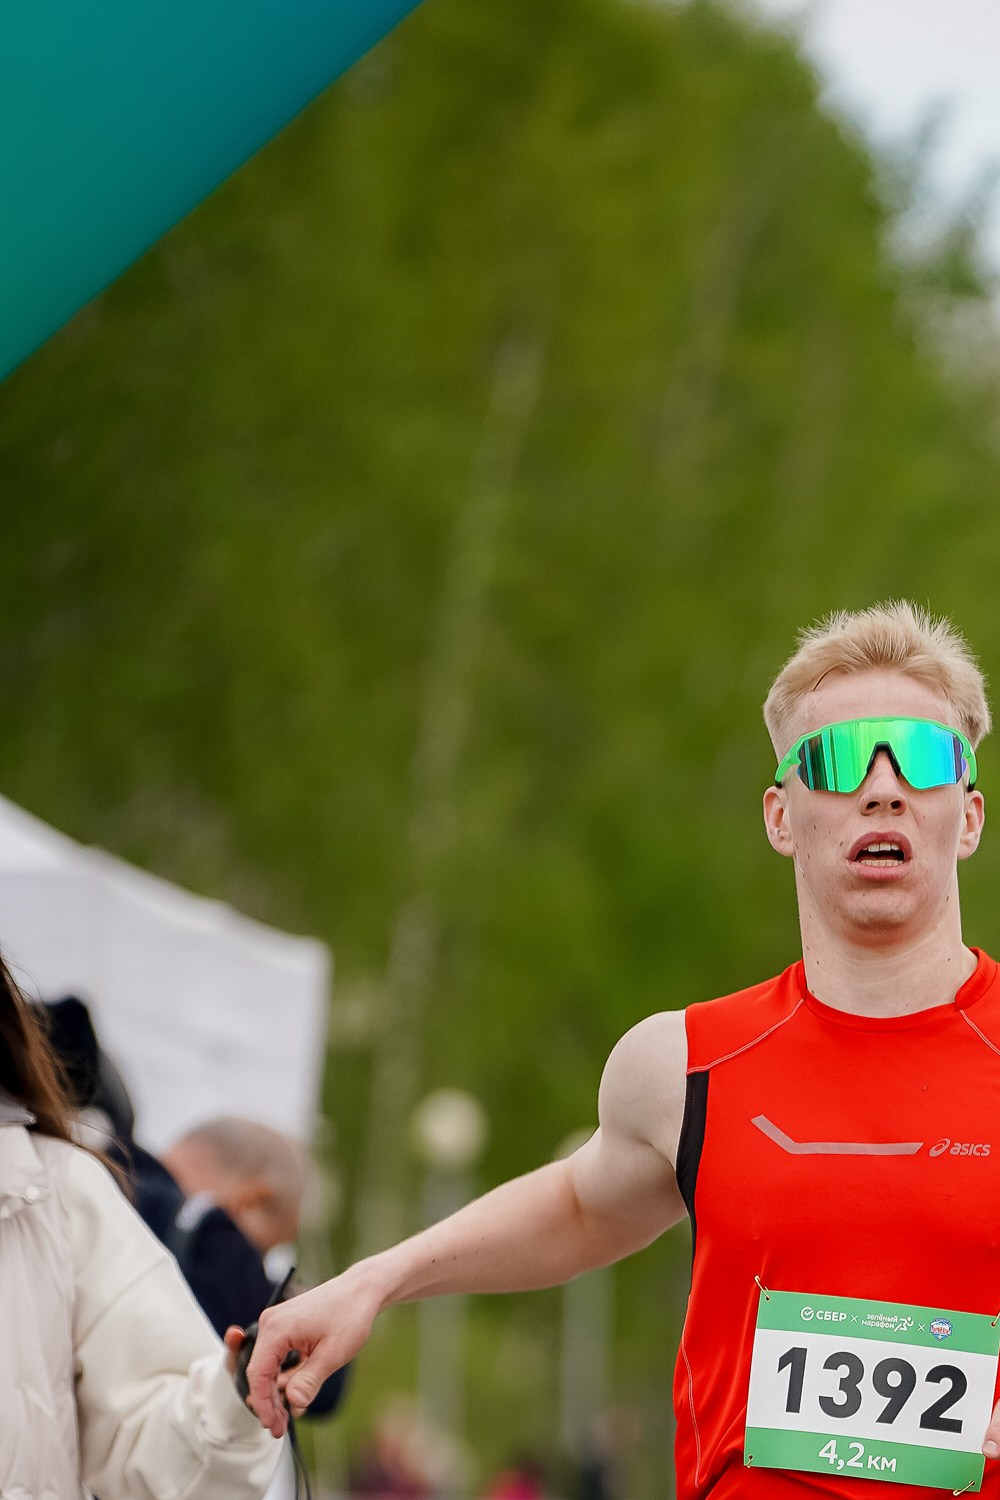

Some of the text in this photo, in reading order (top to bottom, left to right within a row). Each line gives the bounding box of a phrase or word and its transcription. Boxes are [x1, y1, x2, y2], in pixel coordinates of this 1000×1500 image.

[949, 1142, 991, 1156] asics
[816, 1310, 847, 1322] СБЕР
[861, 1320, 895, 1329] марафон
[777, 1346, 968, 1434] 1392
